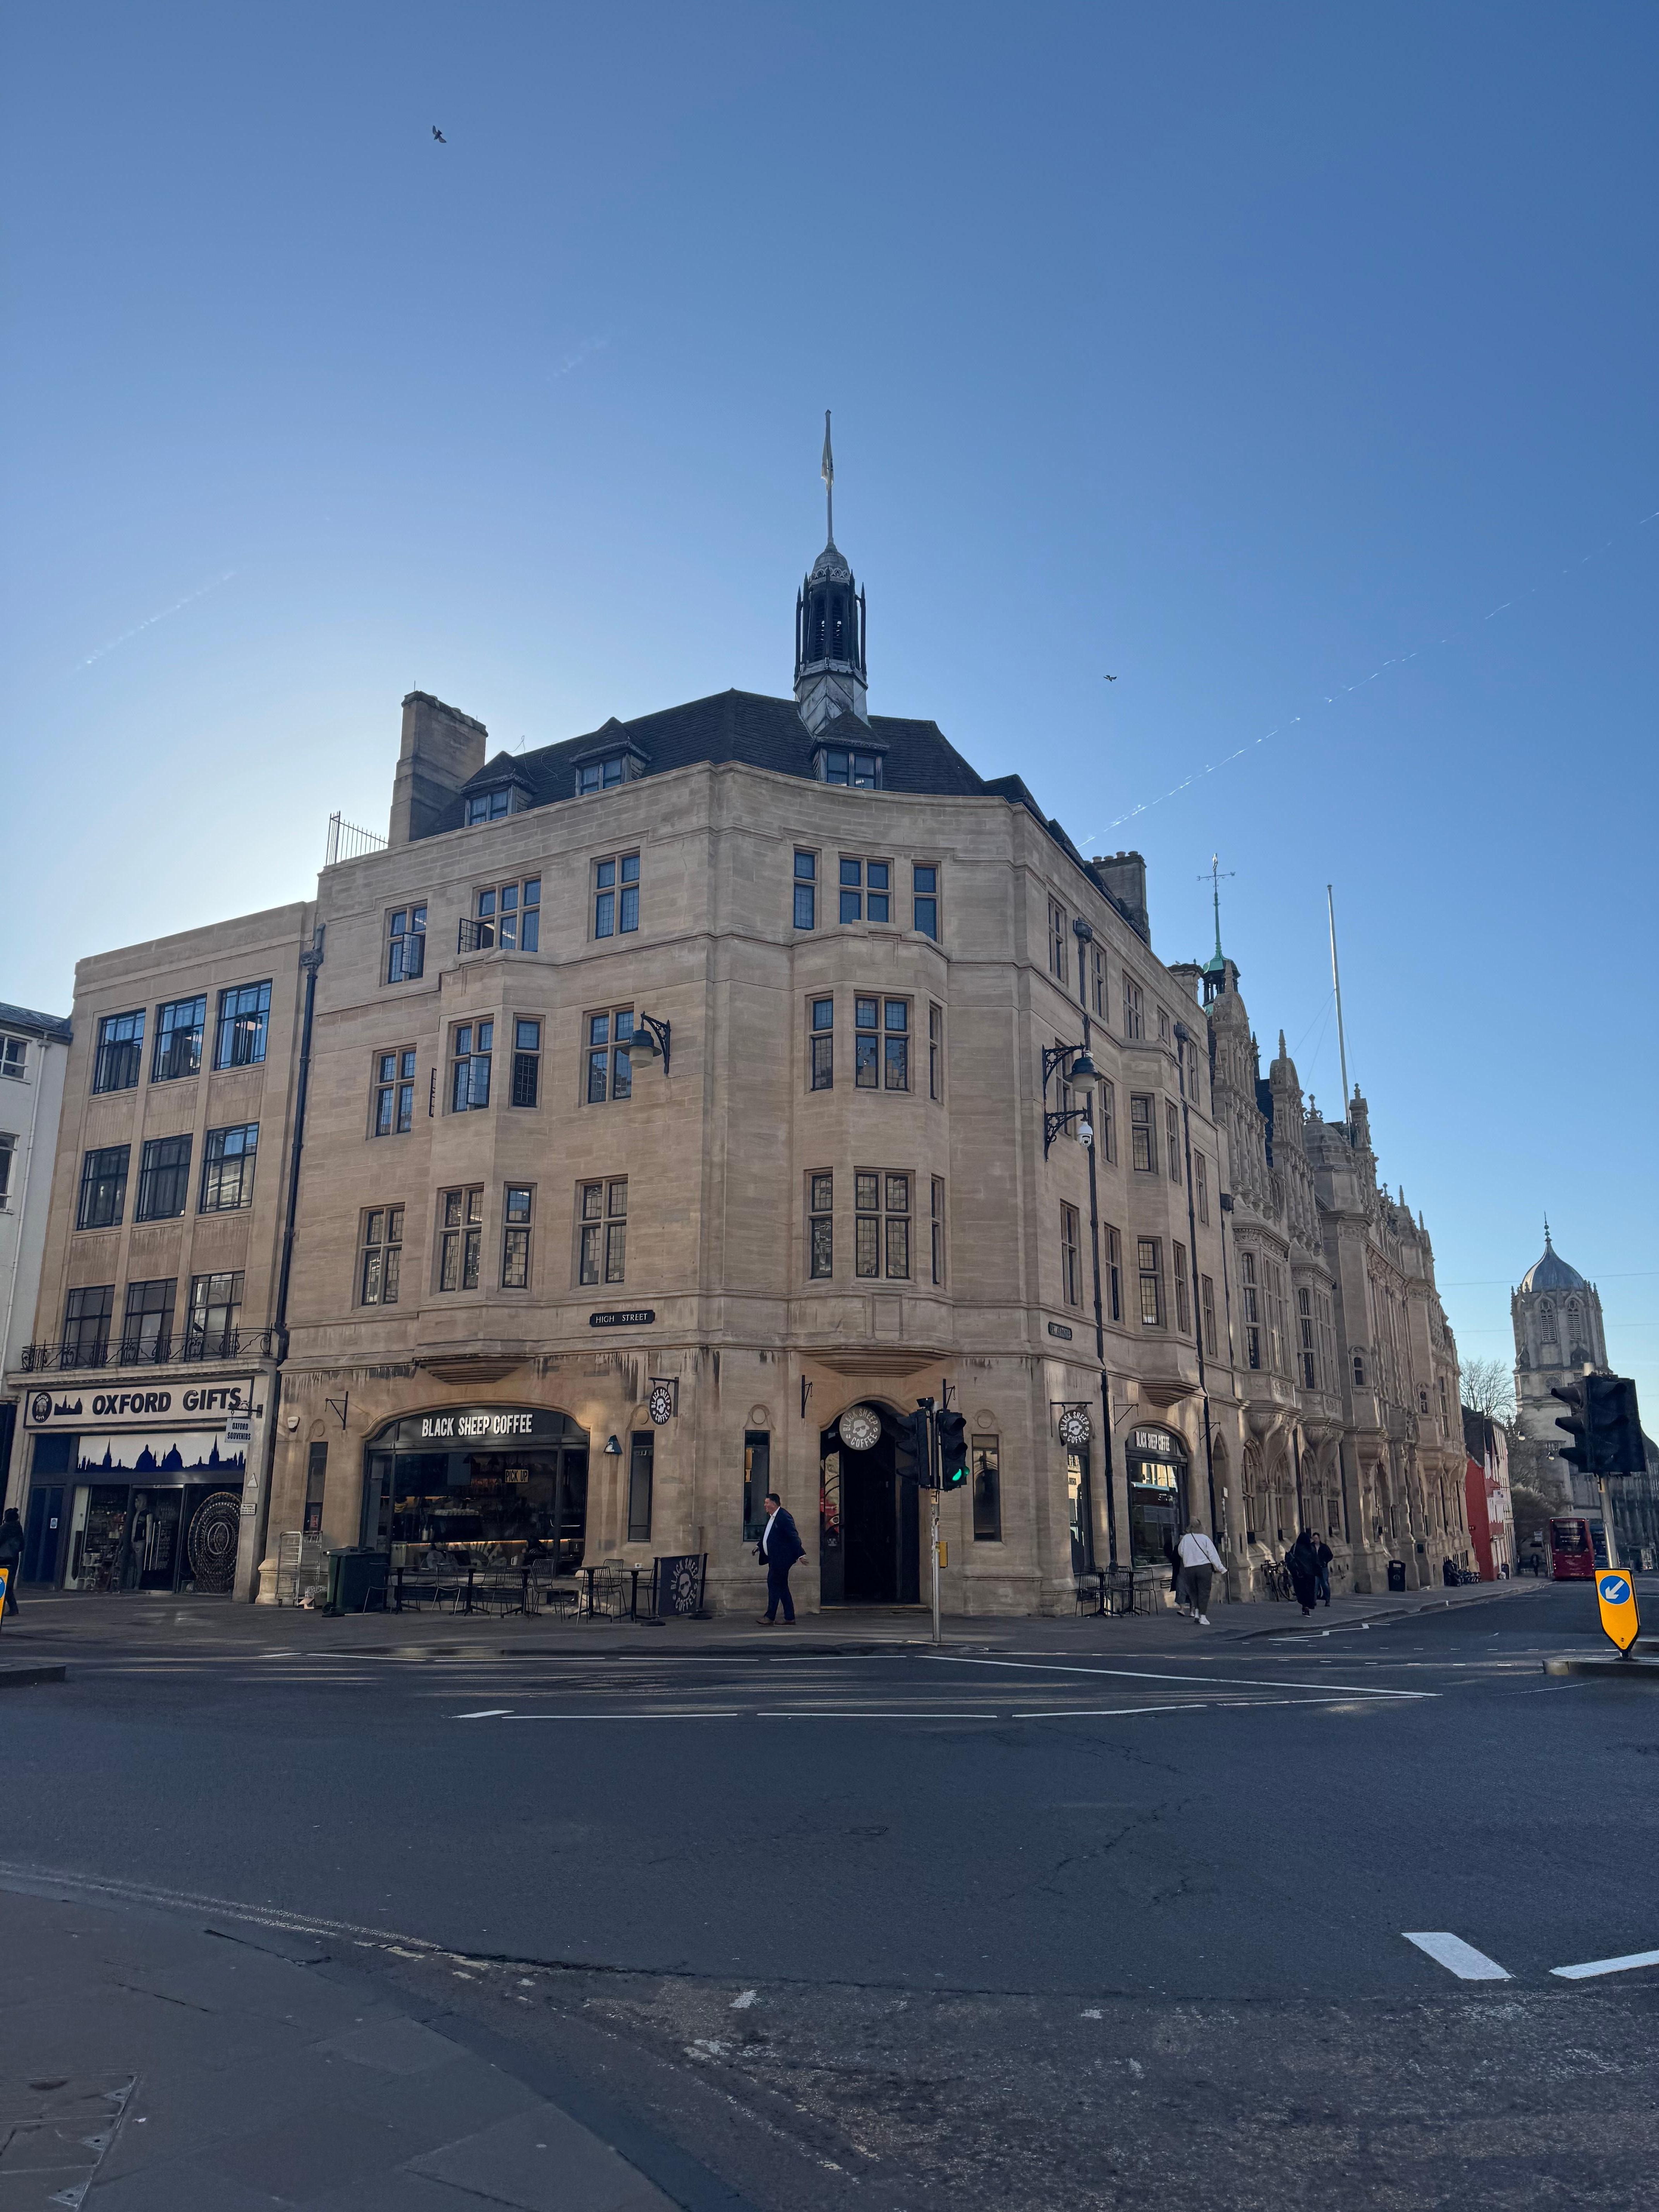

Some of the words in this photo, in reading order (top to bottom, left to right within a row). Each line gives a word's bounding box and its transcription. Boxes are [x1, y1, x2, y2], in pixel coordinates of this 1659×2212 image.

[596, 1315, 615, 1324] HIGH
[622, 1313, 648, 1322] STREET
[92, 1391, 172, 1415] OXFORD
[182, 1387, 242, 1412] GIFTS
[651, 1389, 660, 1408] BLACK
[660, 1388, 670, 1403] SHEEP
[422, 1417, 454, 1437] BLACK
[458, 1416, 490, 1436] SHEEP
[493, 1414, 533, 1434] COFFEE
[655, 1409, 670, 1423] COFFEE
[843, 1410, 858, 1431] BLACK
[859, 1408, 878, 1425] SHEEP
[1060, 1412, 1073, 1431] BLACK
[1073, 1411, 1089, 1425] SHEEP
[850, 1432, 878, 1448] COFFEE
[1067, 1431, 1089, 1444] COFFEE
[505, 1470, 517, 1482] PICK
[520, 1470, 528, 1482] UP
[670, 1559, 684, 1590] BLACK
[675, 1589, 696, 1611] COFFEE
